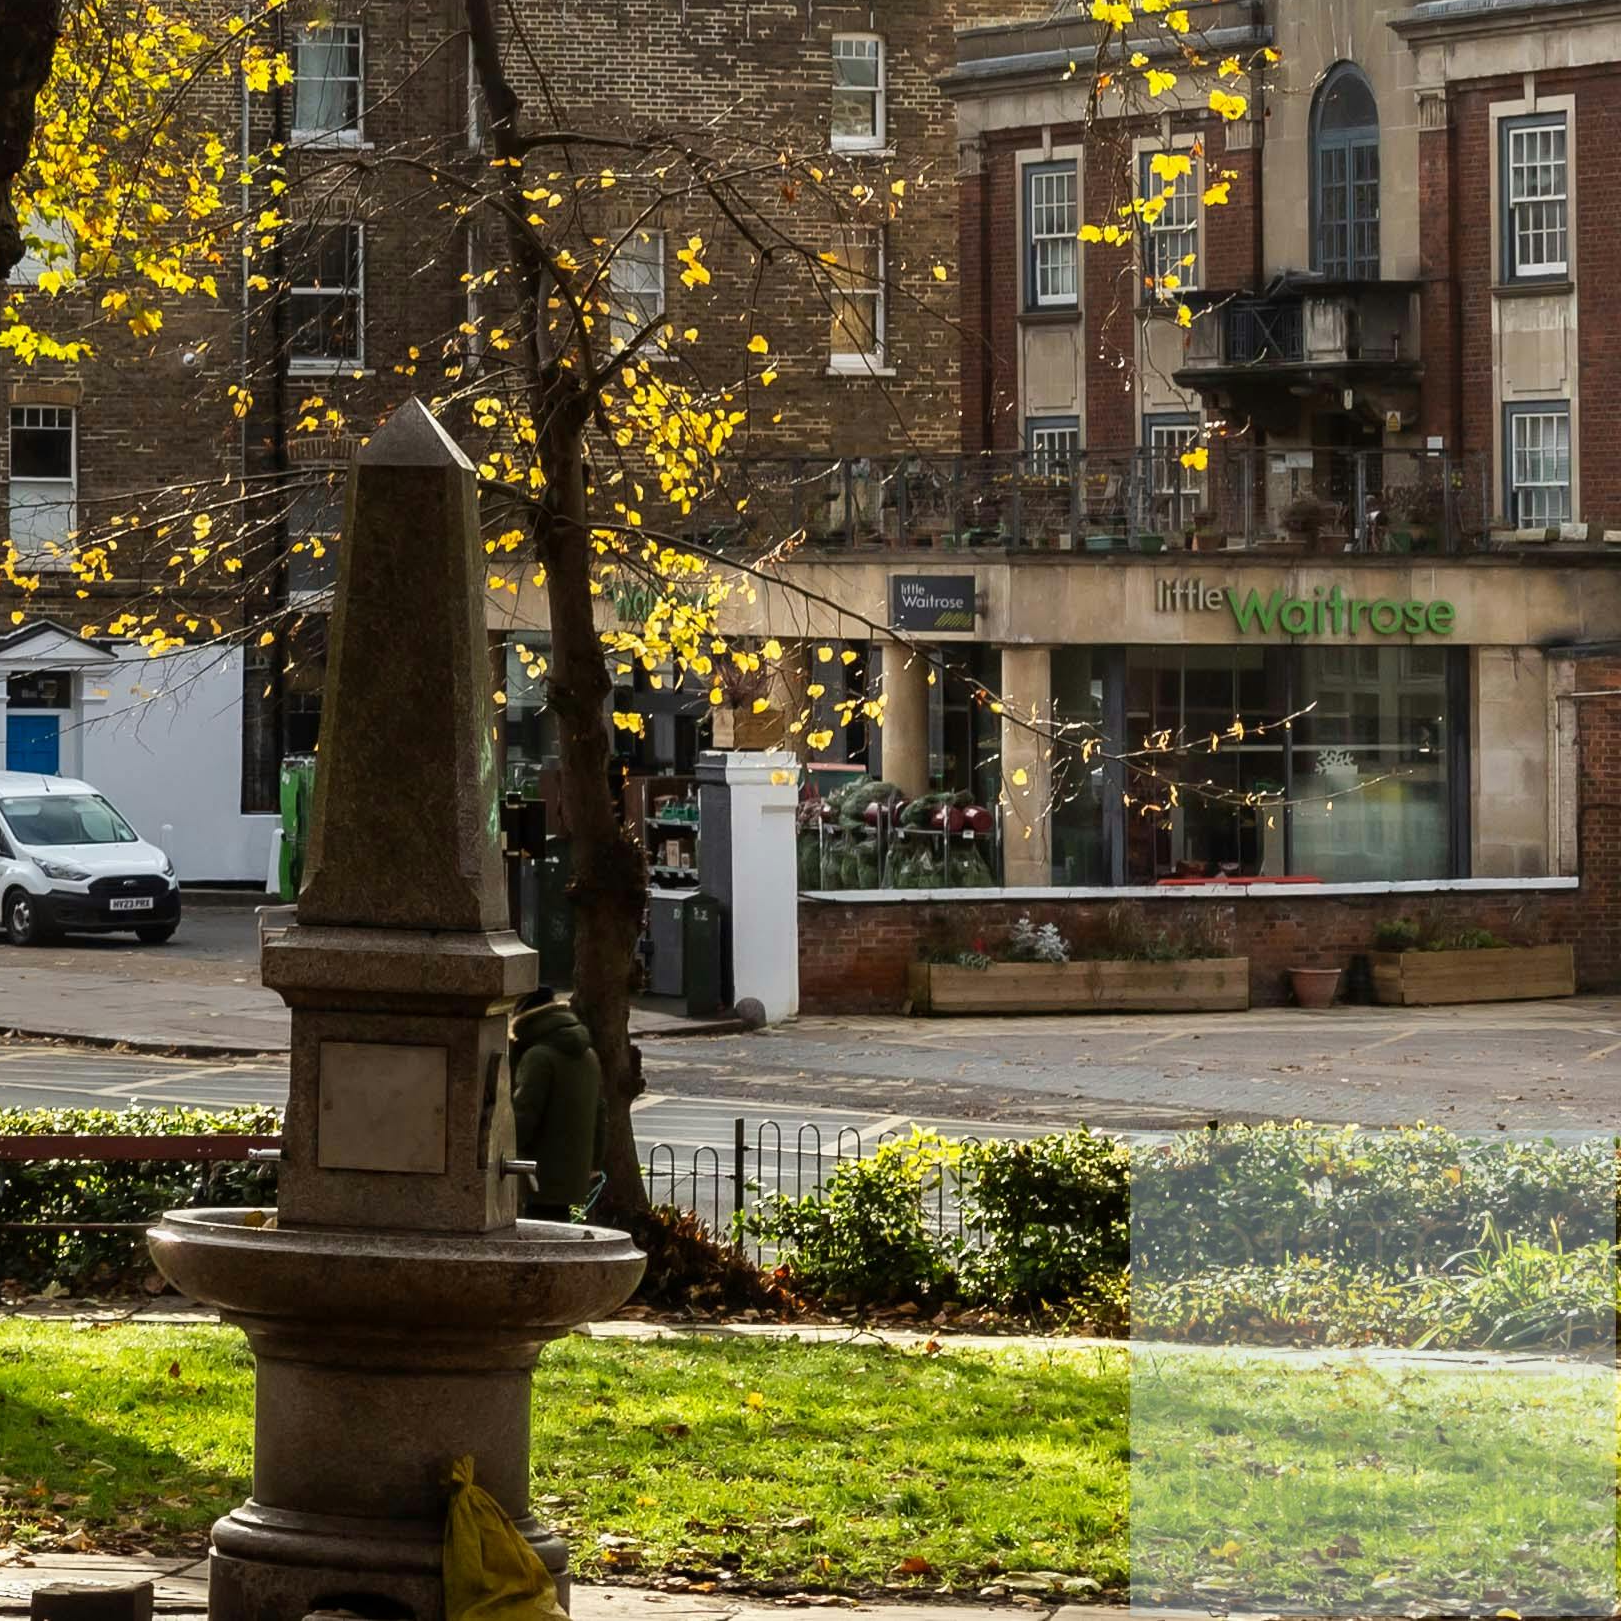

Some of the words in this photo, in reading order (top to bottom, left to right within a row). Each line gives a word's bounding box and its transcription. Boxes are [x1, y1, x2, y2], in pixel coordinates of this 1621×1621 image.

[901, 583, 925, 595] little
[902, 594, 964, 608] Waitrose
[1157, 579, 1223, 611] little
[1225, 585, 1455, 635] Waitrose
